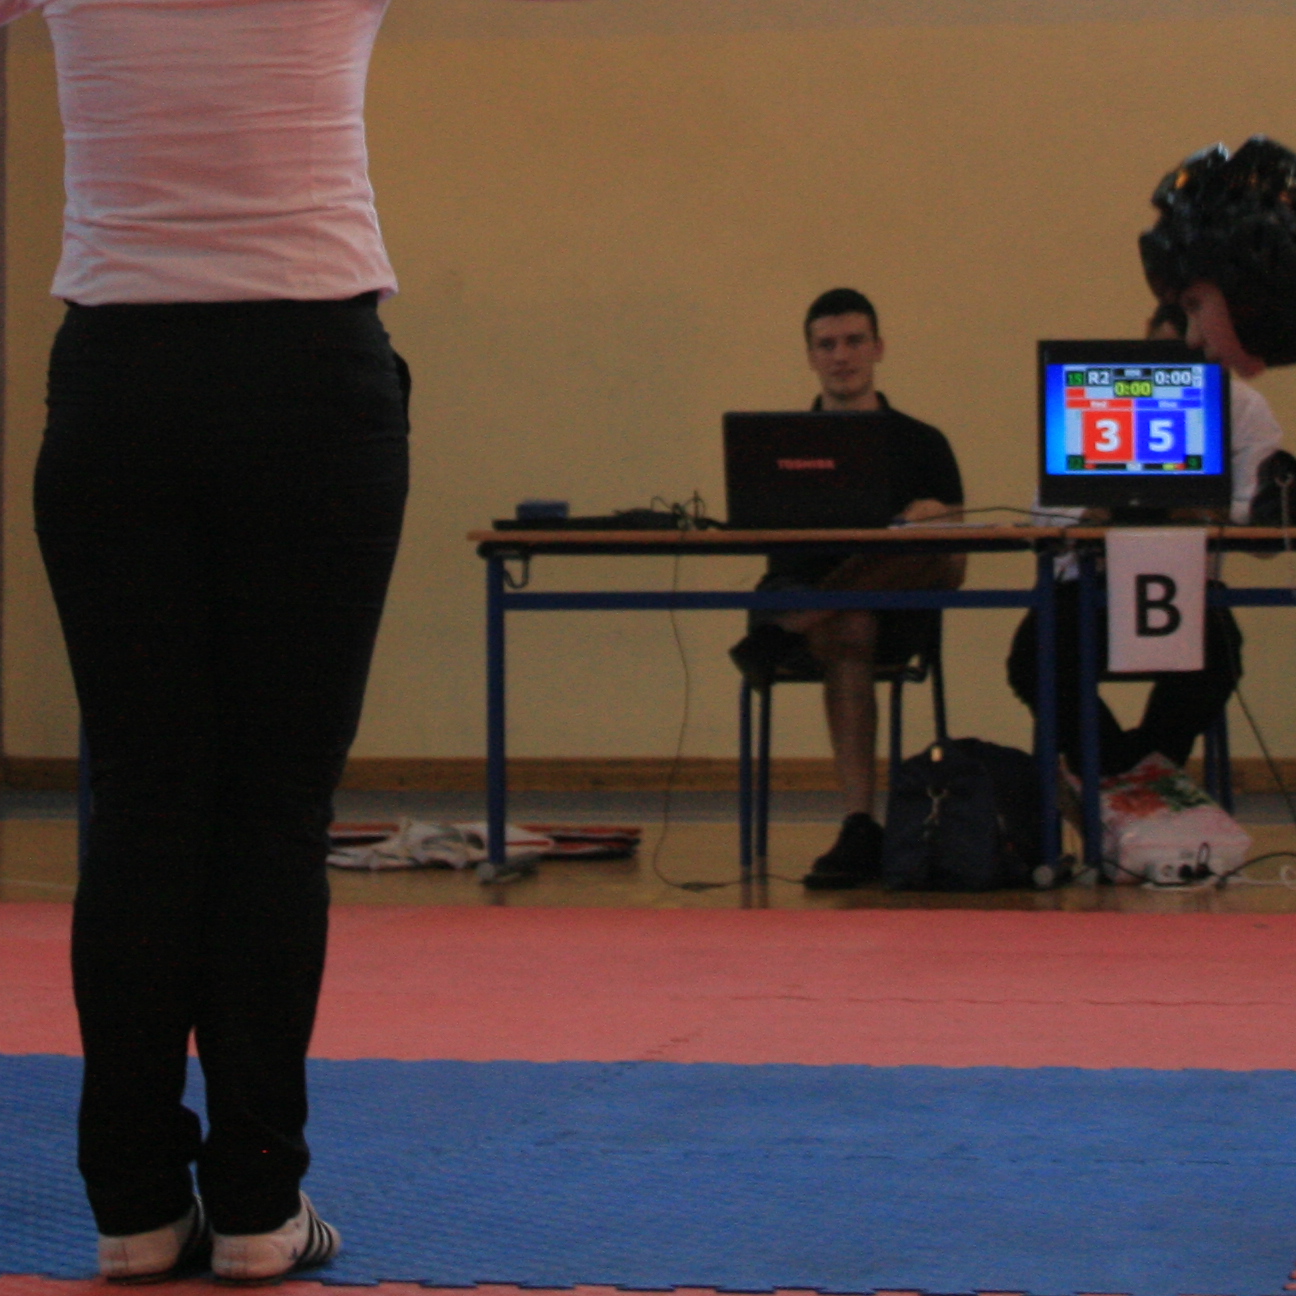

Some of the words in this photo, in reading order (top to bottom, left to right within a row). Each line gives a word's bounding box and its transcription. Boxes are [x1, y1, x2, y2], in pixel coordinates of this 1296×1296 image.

[1088, 371, 1110, 385] R2
[1115, 381, 1151, 396] 0:00
[1155, 370, 1191, 385] 0:00
[1095, 418, 1121, 452] 3
[1149, 419, 1174, 452] 5
[1136, 574, 1181, 637] B
